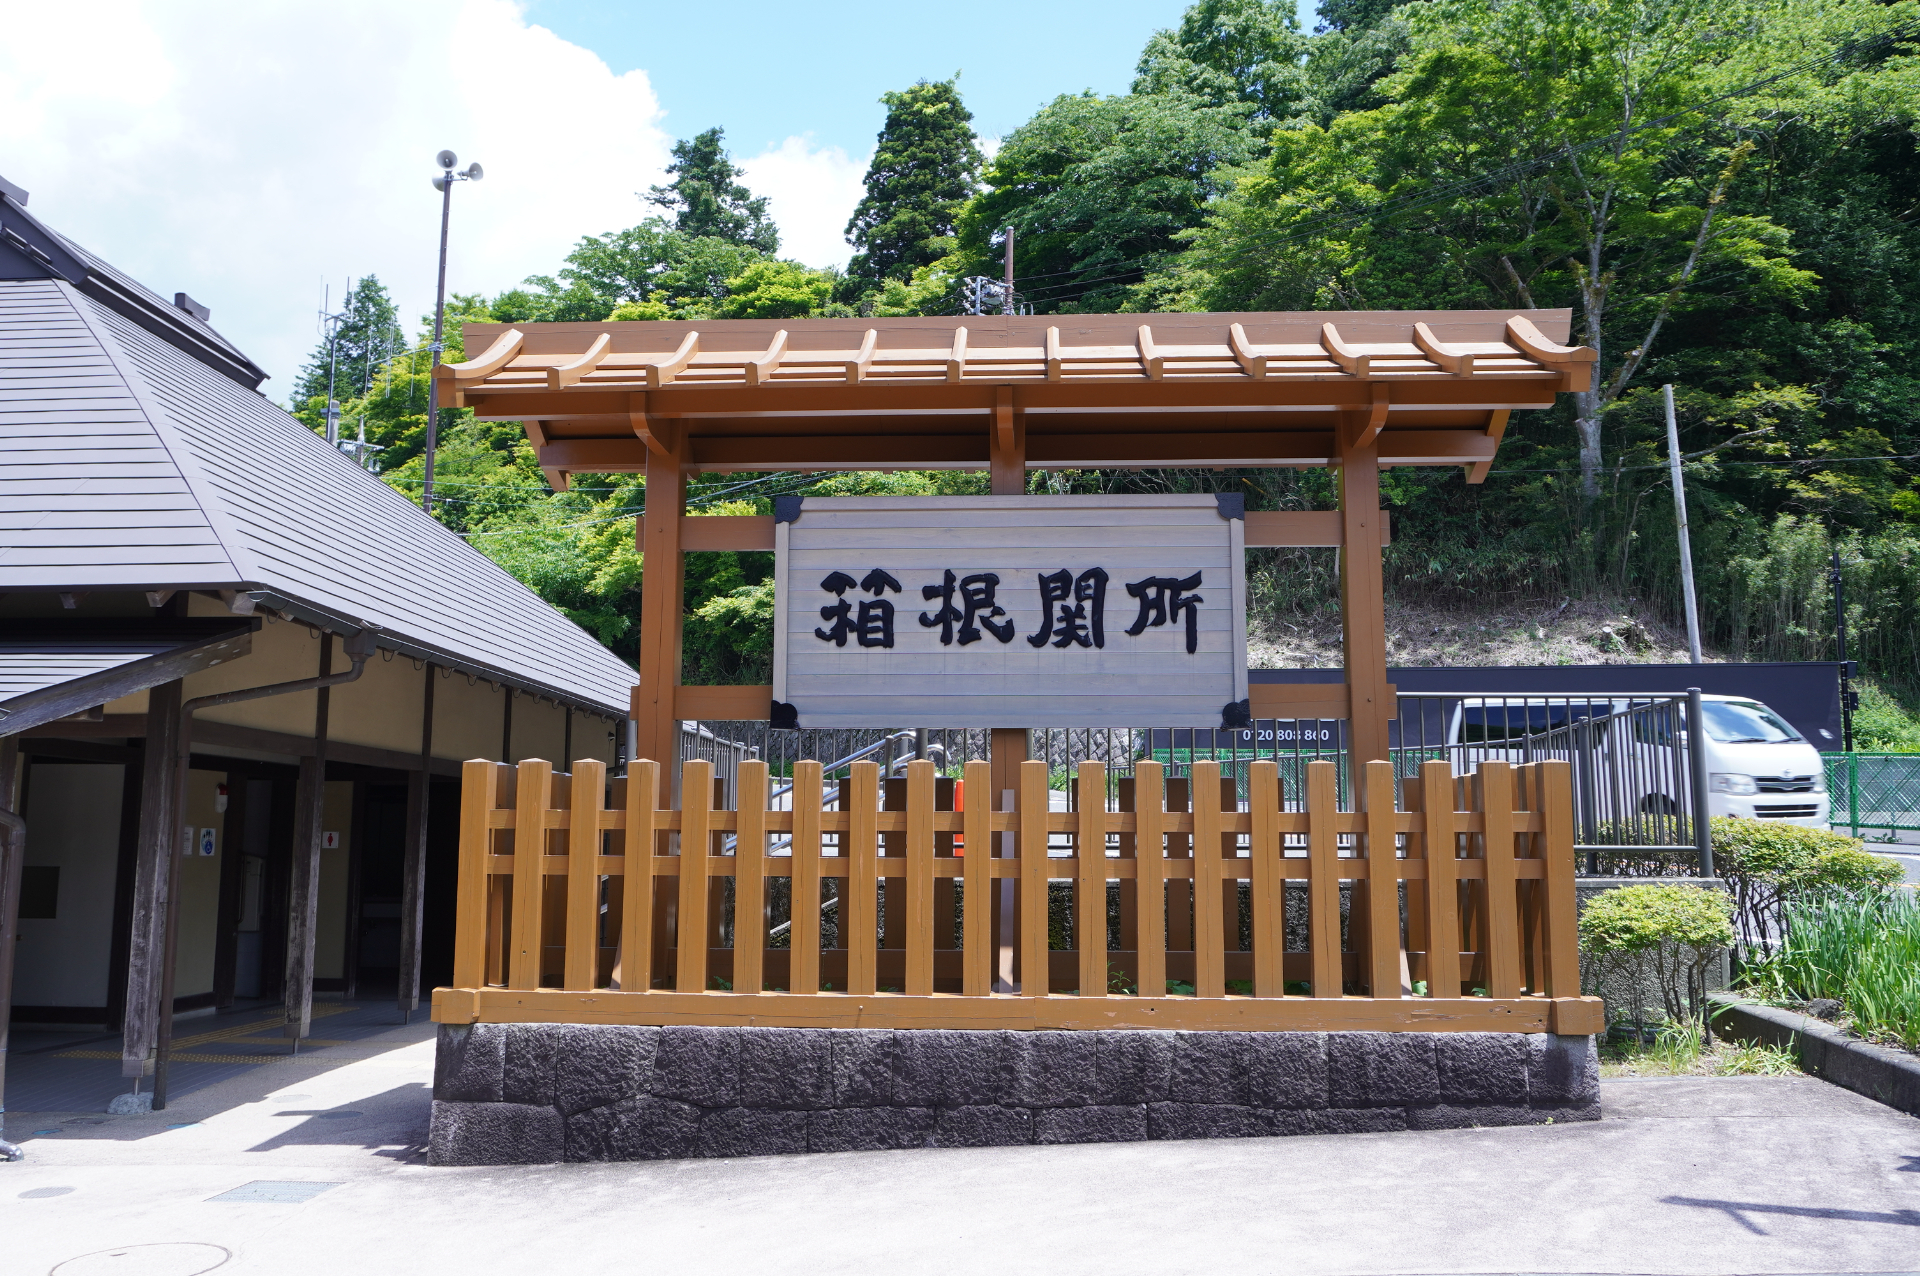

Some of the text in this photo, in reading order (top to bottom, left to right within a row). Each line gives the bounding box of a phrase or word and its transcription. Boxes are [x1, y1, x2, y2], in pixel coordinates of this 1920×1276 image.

[814, 566, 1204, 655] 箱根関所
[1243, 729, 1274, 741] 020
